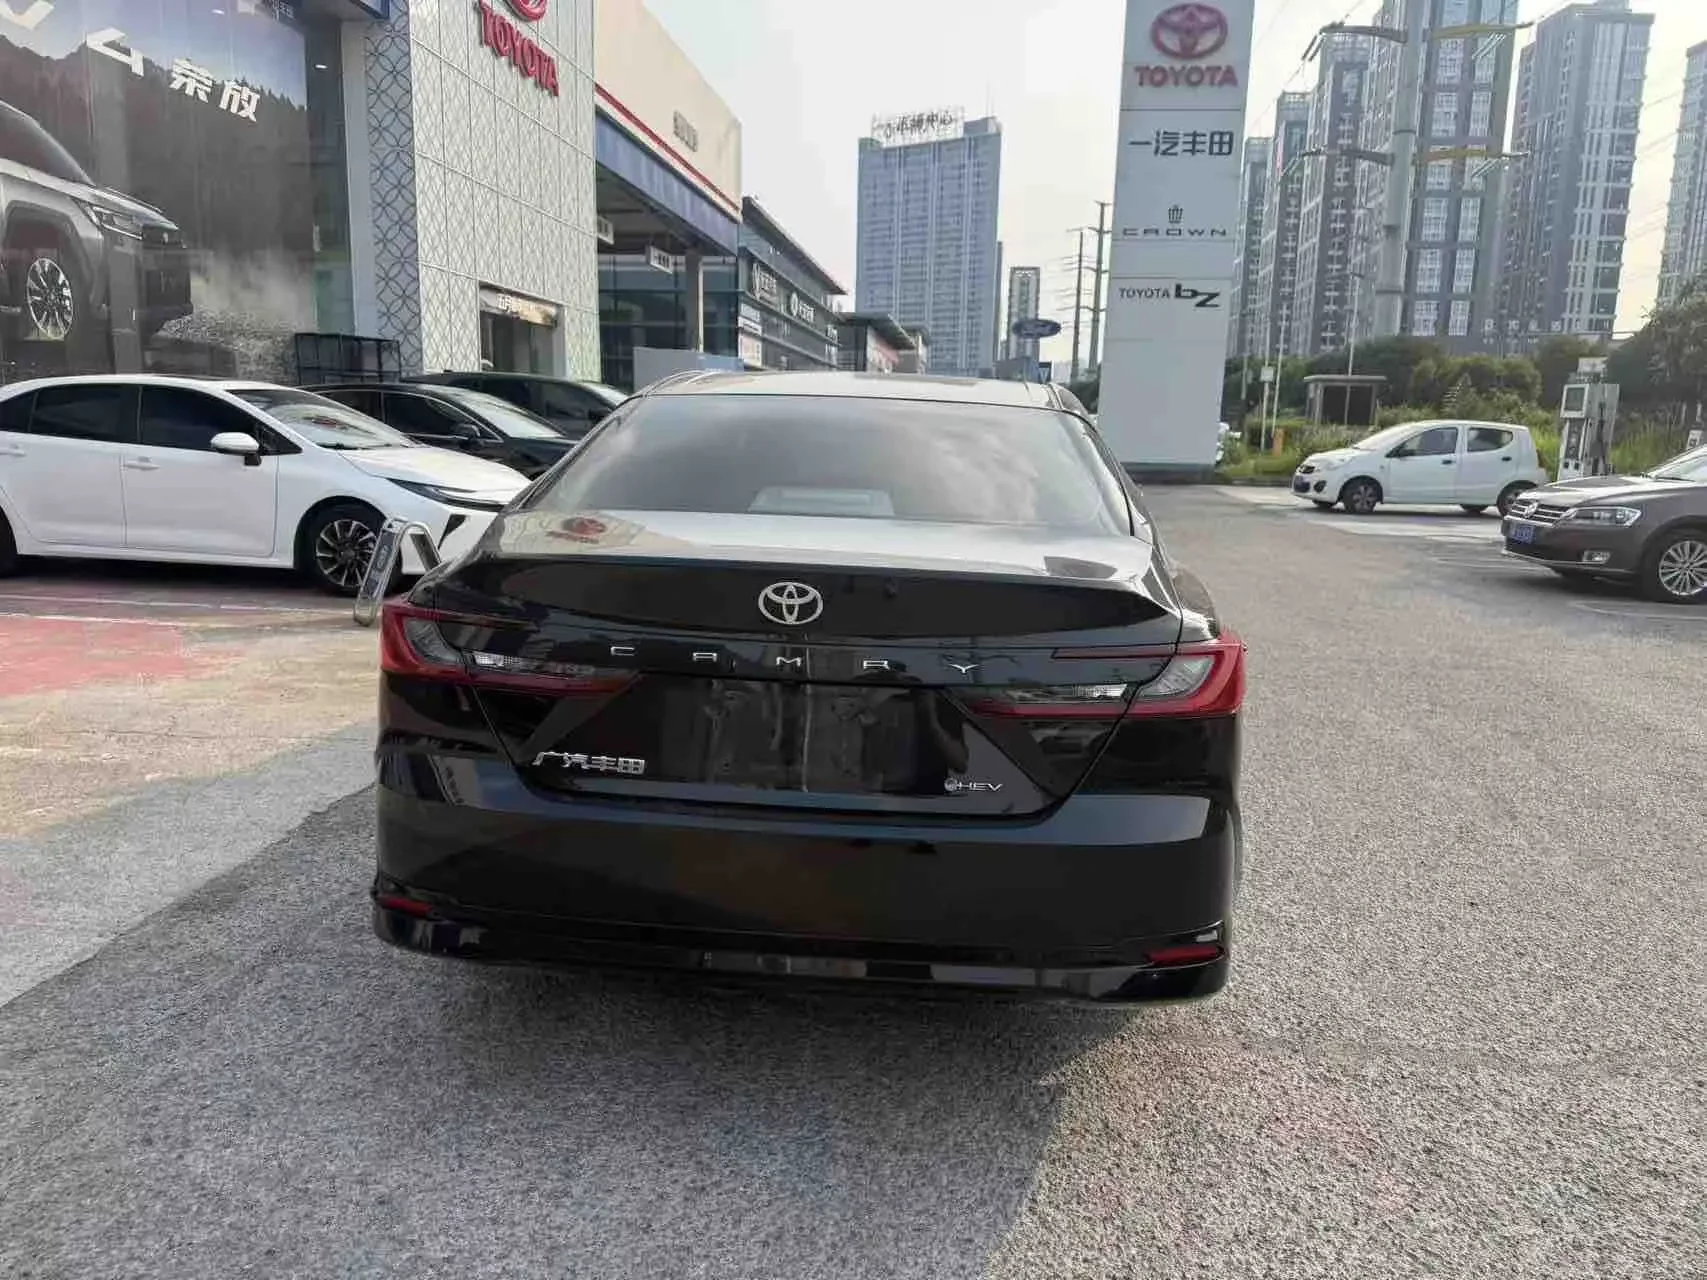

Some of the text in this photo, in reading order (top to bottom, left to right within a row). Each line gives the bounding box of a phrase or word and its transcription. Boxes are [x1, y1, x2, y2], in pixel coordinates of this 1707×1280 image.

[480, 0, 560, 97] TOYOTA
[1134, 65, 1237, 88] TOYOTA
[169, 57, 260, 122] 荣放
[1129, 130, 1234, 156] 一汽丰田
[1123, 228, 1226, 236] CROWN
[1119, 287, 1170, 298] TOYOTA
[610, 645, 979, 674] CAMRY
[531, 751, 645, 775] 广汽丰田
